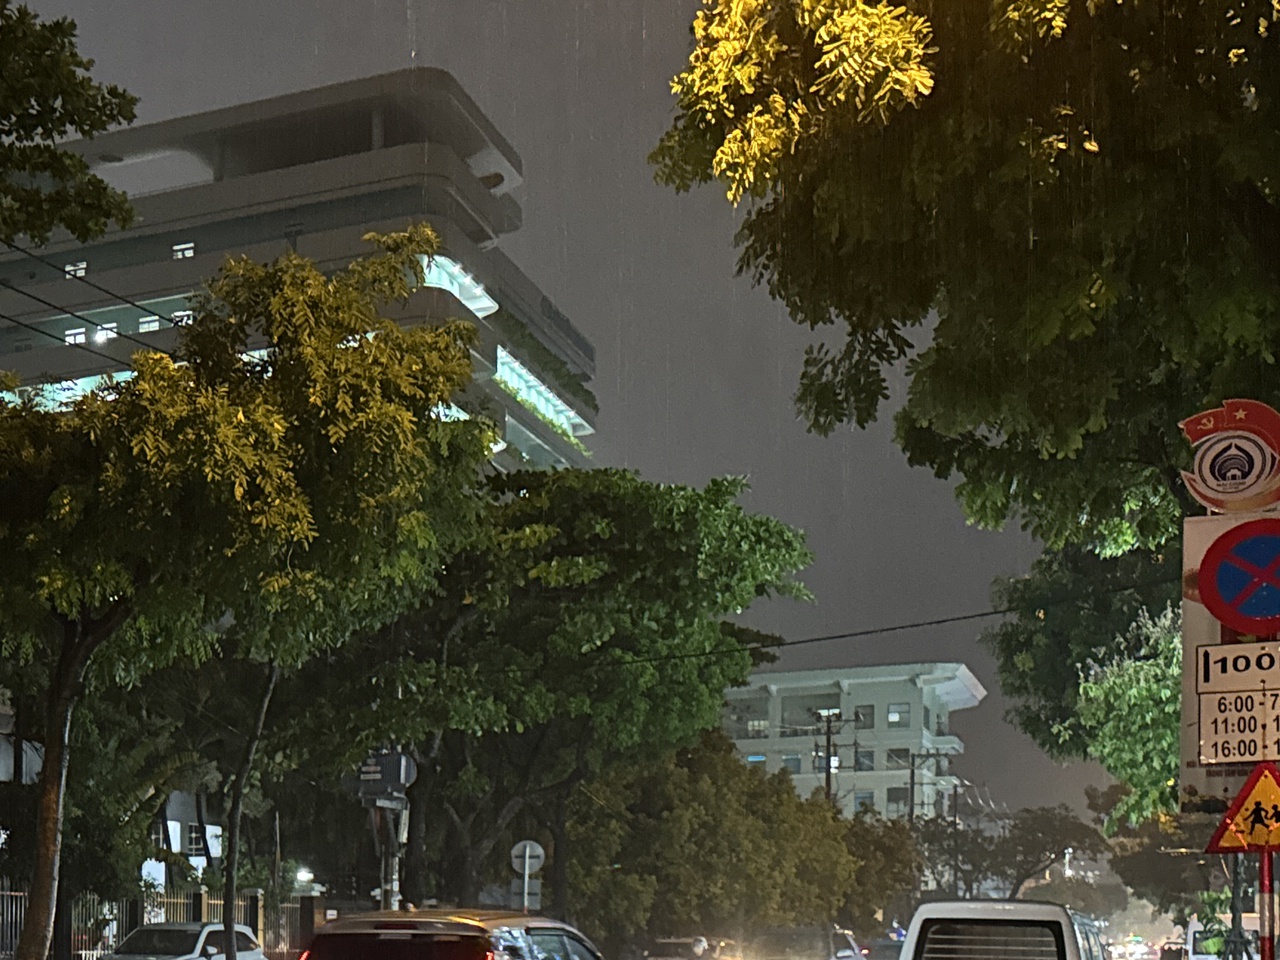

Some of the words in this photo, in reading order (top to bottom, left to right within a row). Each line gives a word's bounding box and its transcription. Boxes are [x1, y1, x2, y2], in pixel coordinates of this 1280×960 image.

[1217, 695, 1254, 713] 6:00
[1211, 715, 1257, 735] 11:00
[1211, 739, 1257, 758] 16:00
